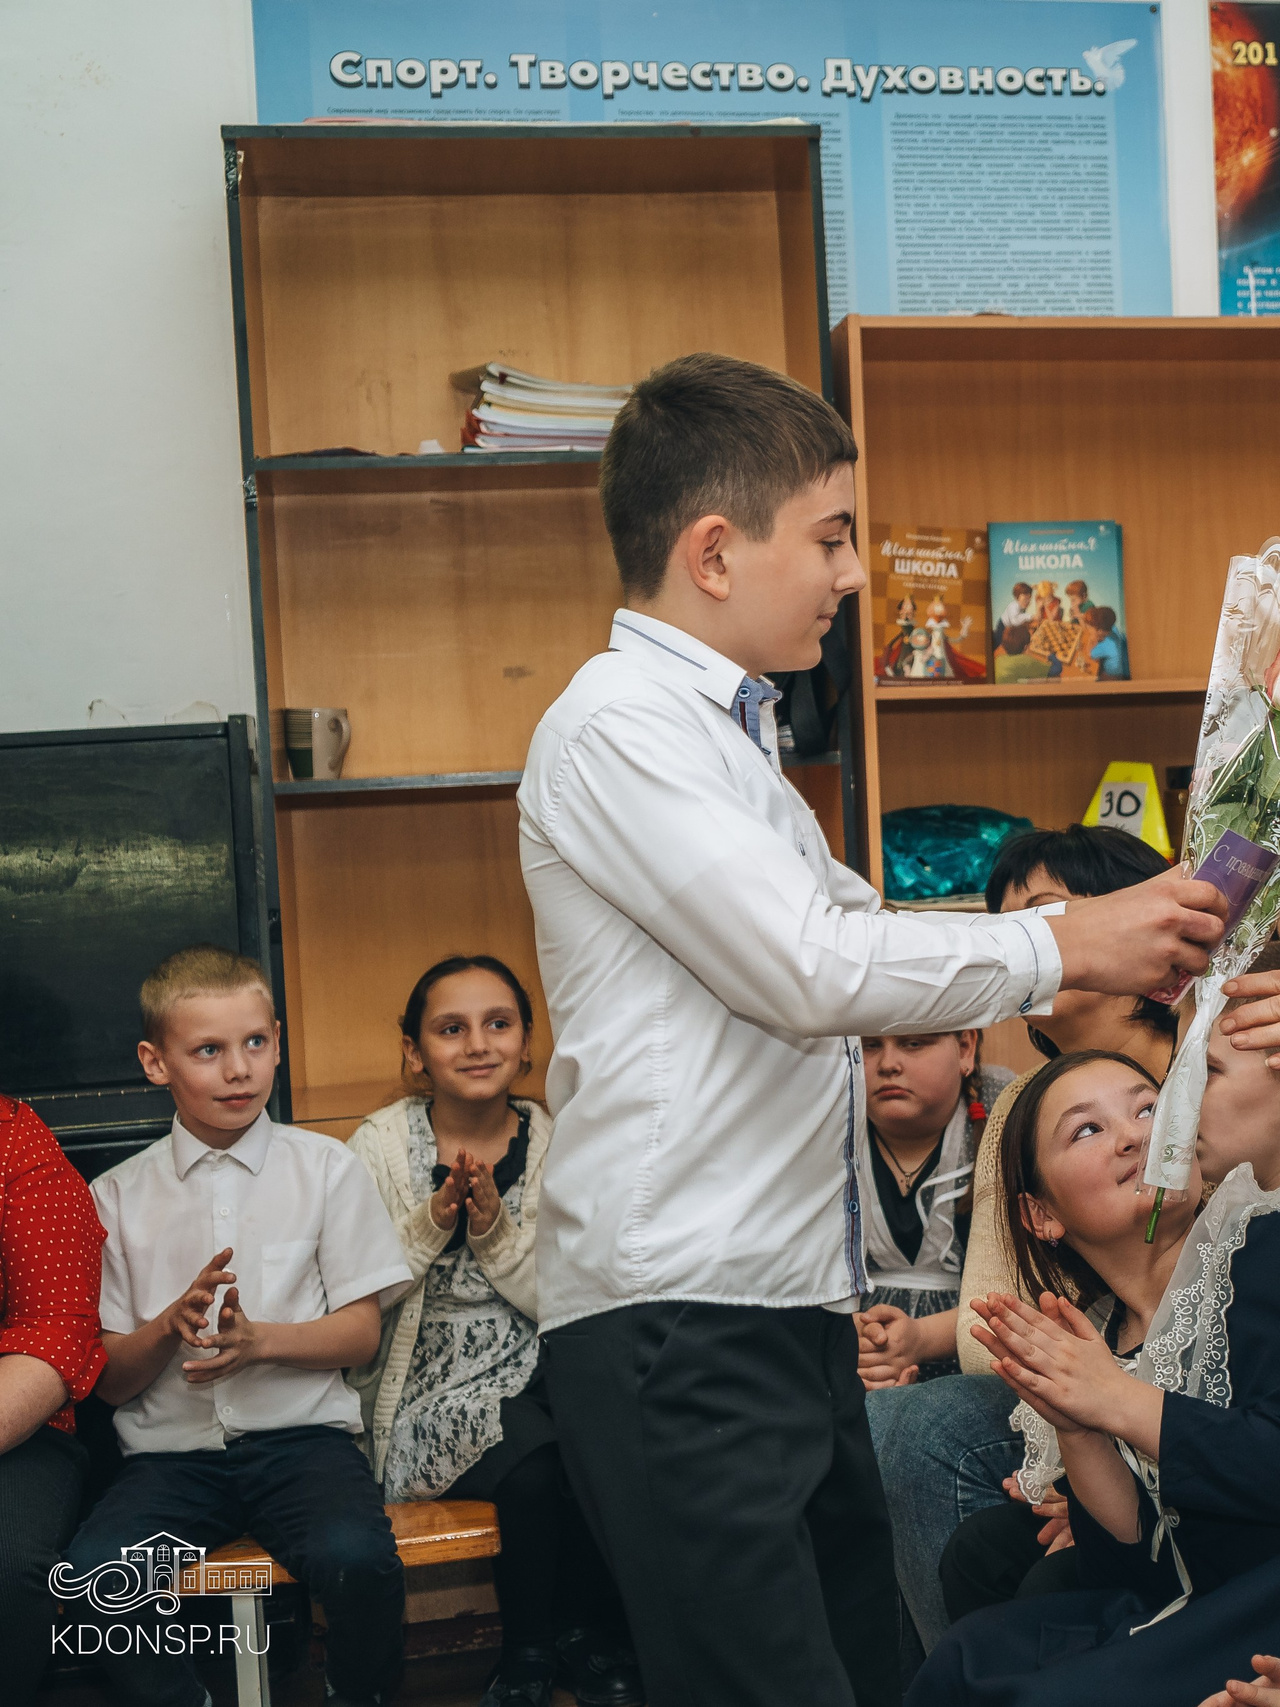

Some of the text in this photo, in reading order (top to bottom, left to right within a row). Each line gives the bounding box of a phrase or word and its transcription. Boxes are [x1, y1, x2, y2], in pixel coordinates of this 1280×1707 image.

[329, 49, 1107, 103] Спорт. Творчество. Духовность.
[893, 558, 959, 579] ШКОЛА
[1018, 554, 1084, 571] ШКОЛА
[1100, 790, 1141, 817] 30
[1213, 844, 1231, 863] С
